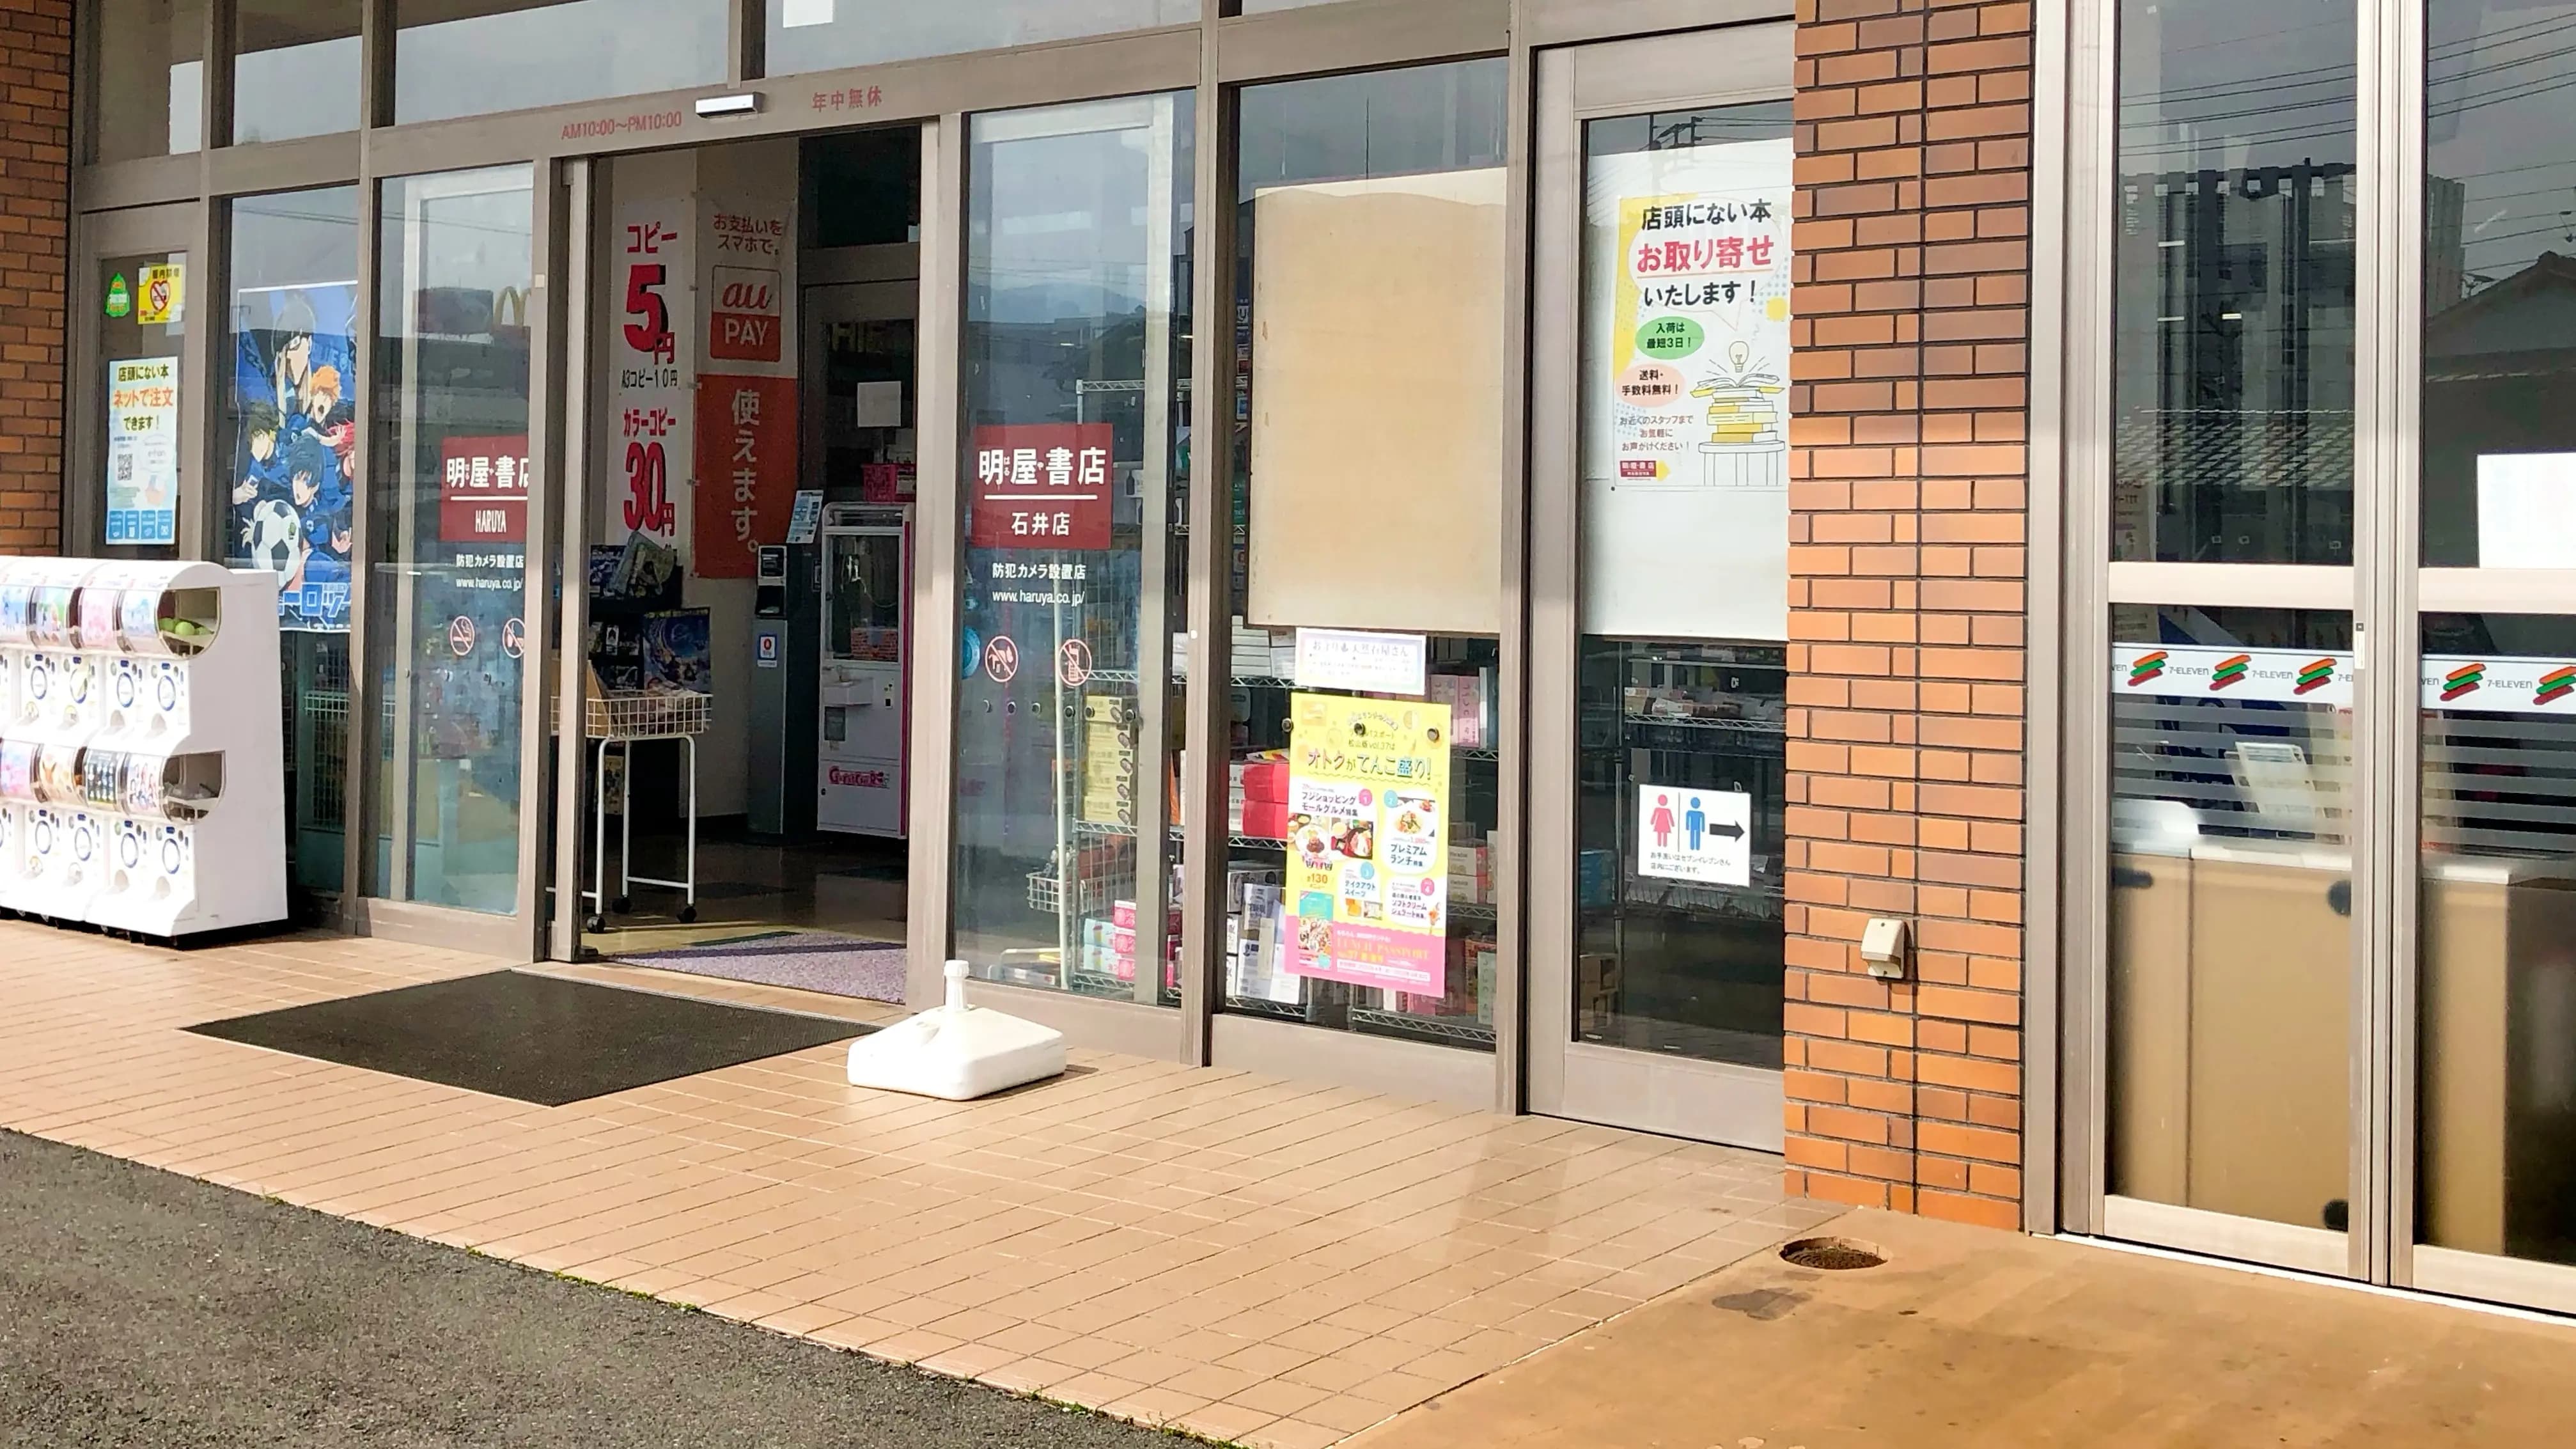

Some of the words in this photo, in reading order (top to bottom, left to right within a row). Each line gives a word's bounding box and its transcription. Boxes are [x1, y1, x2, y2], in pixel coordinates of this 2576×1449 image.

[812, 85, 882, 113] 年中無休
[714, 214, 783, 236] お支払いを
[1642, 198, 1772, 230] 店頭にない本
[627, 221, 678, 253] コピー
[717, 234, 779, 256] スマホで。
[1637, 235, 1774, 273] お取り寄せ
[722, 283, 772, 309] au
[1644, 280, 1756, 307] いたします！
[724, 318, 769, 346] PAY
[1655, 322, 1685, 334] 入荷は
[1646, 337, 1691, 349] 最短3日！
[118, 363, 169, 382] 店頭にない本
[113, 386, 175, 408] ネットで注文
[1621, 384, 1678, 396] 手数料無料！
[123, 414, 160, 431] できます！
[623, 407, 676, 437] カラーコピー
[1620, 415, 1694, 426] お近くのスタッフまで
[1621, 441, 1689, 451] お声がけください！
[731, 389, 760, 552] 使えます。
[623, 442, 675, 538] 30円
[475, 510, 507, 533] HARUYA
[1011, 512, 1071, 537] 石井店
[456, 553, 524, 568] 防犯カメラ設置店
[992, 562, 1086, 580] 防犯カメラ設置店
[992, 589, 1086, 607] www.haruya.co.jp/
[1302, 791, 1357, 805] フジショッピング
[1391, 843, 1428, 856] プレミアム
[1392, 899, 1427, 911] ソフトクリーム
